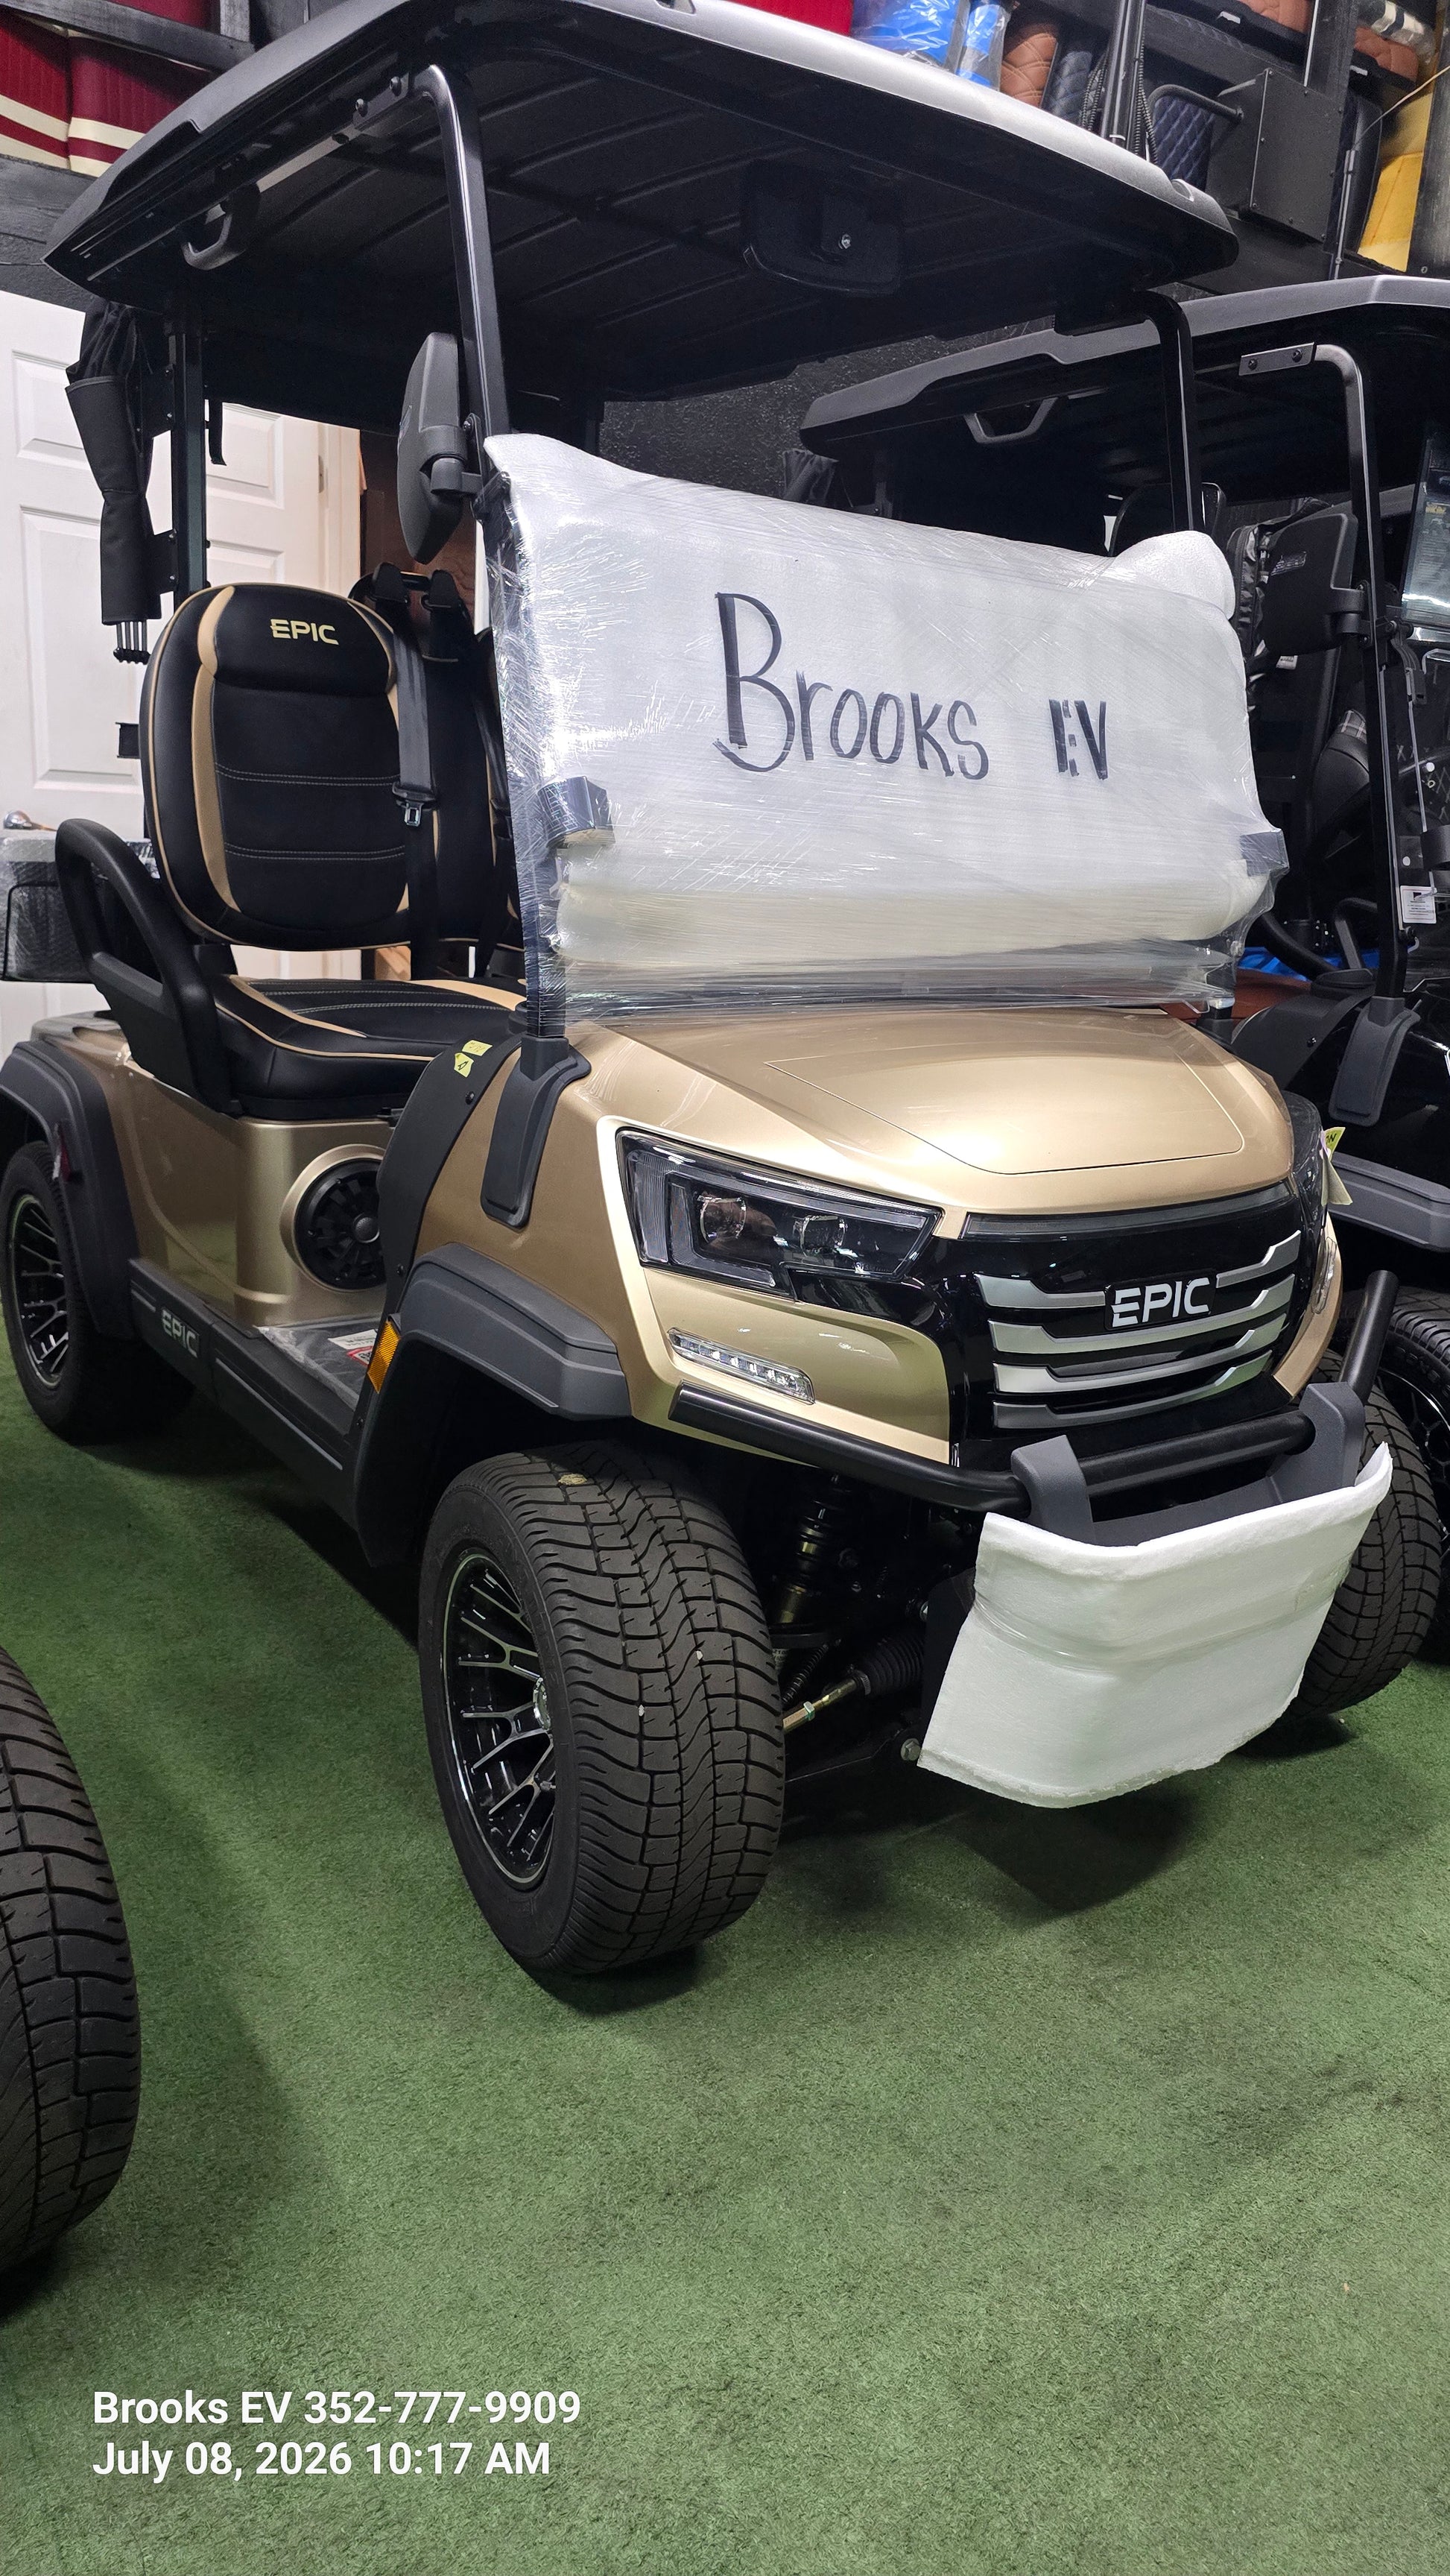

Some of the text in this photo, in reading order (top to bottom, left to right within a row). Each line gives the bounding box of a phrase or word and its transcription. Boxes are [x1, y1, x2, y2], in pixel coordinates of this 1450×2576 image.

[270, 618, 340, 645] EPIC
[1048, 698, 1108, 781] EV
[1110, 1277, 1211, 1328] EPIC
[162, 1309, 198, 1358] EPIC
